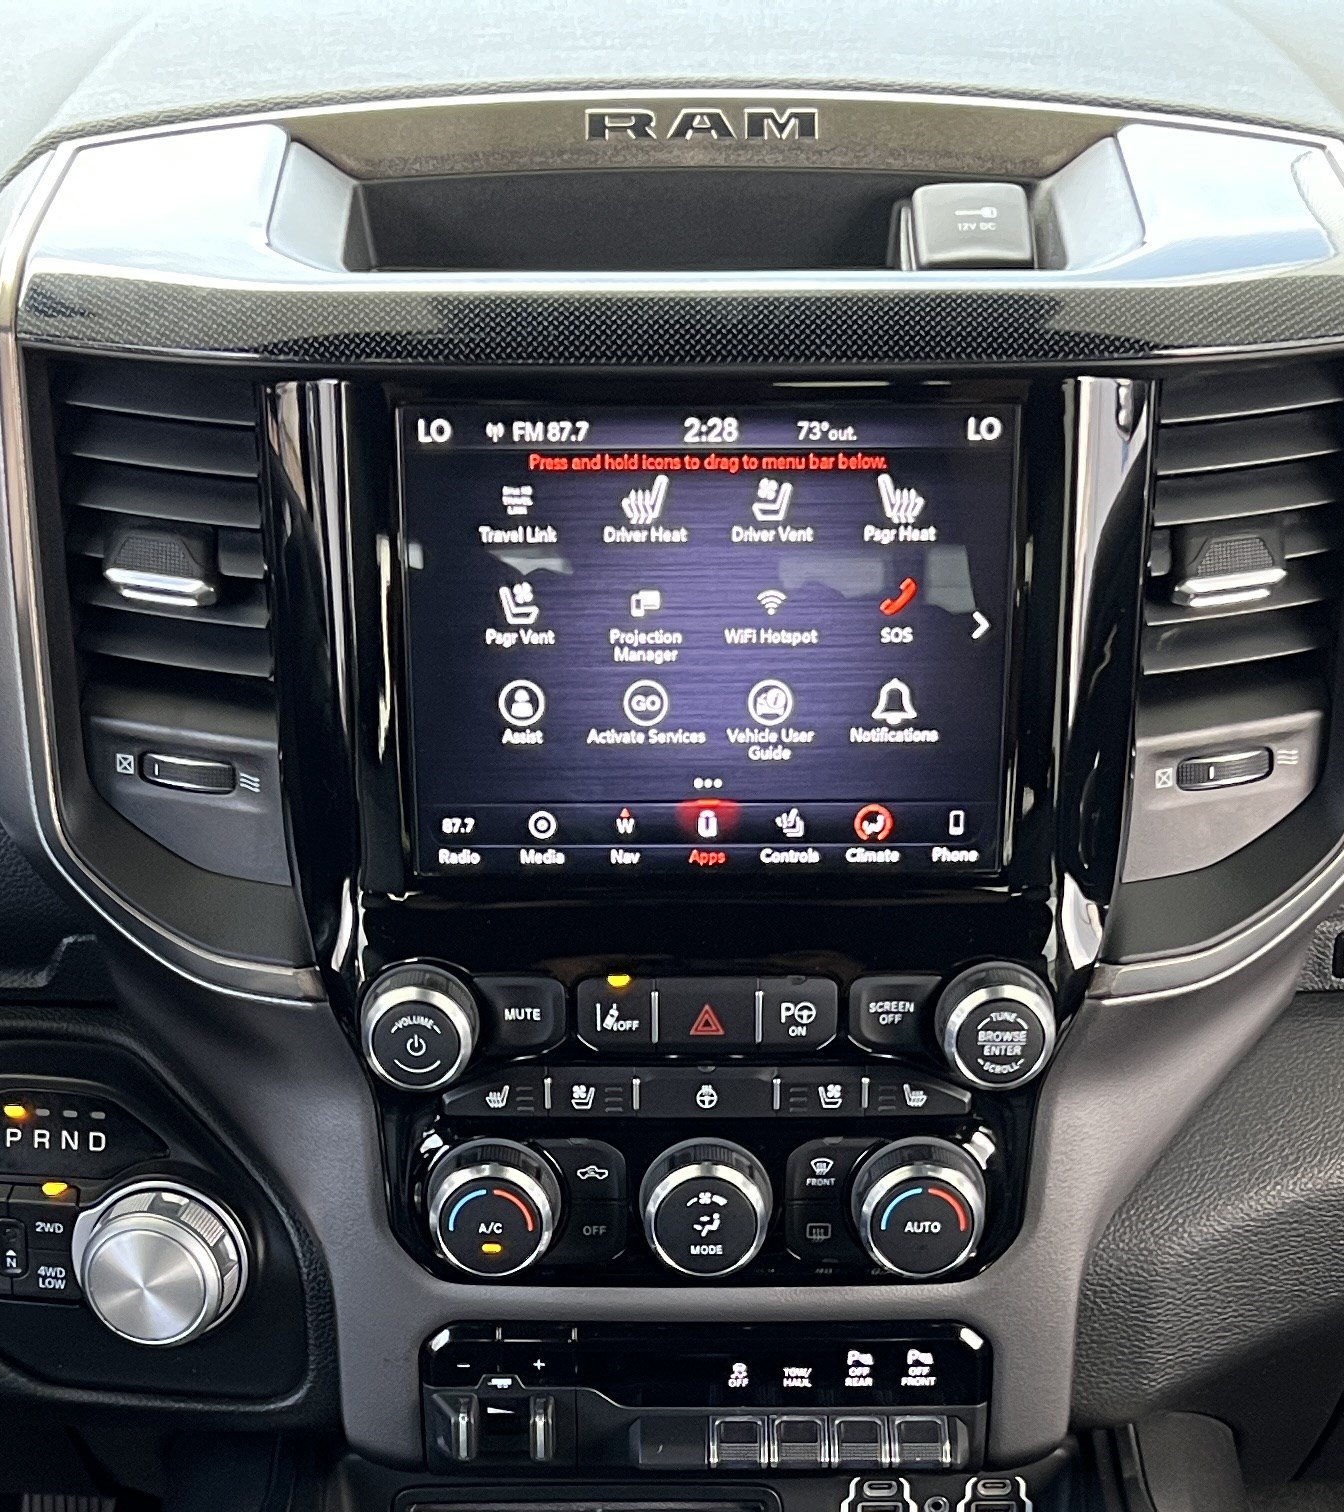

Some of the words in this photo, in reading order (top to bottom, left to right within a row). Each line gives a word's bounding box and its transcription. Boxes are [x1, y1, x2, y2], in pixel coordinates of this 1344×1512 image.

[585, 107, 818, 140] RAM
[957, 222, 977, 231] 12V
[417, 418, 452, 443] LO
[512, 421, 543, 442] FM
[546, 421, 589, 442] 87.7
[683, 417, 739, 443] 2:28
[967, 416, 1002, 441] LO
[528, 453, 568, 470] Press
[572, 453, 602, 470] and
[605, 453, 638, 470] hold
[642, 453, 681, 470] icons
[684, 453, 700, 470] to
[704, 453, 739, 474] drag
[743, 453, 759, 470] to
[762, 457, 806, 470] menu
[809, 453, 835, 470] bar
[838, 453, 888, 470] below.
[479, 525, 524, 543] Travel
[526, 525, 557, 543] Link
[604, 525, 647, 543] Driver
[650, 526, 688, 543] Heat
[731, 525, 775, 542] Driver
[778, 525, 814, 542] Vent
[863, 525, 897, 544] Psgr
[898, 525, 936, 542] Heat
[485, 628, 518, 648] Psgr
[519, 629, 555, 645] Vent
[609, 628, 682, 647] Projection
[724, 628, 757, 645] WiFi
[759, 628, 818, 646] Hotspot
[880, 627, 913, 644] SOS
[613, 646, 678, 664] Manager
[631, 694, 661, 712] GO
[502, 728, 544, 744] Assist
[586, 728, 645, 744] Activate
[648, 728, 706, 744] Services
[726, 728, 778, 744] Vehicle
[781, 728, 815, 744] User
[850, 727, 939, 743] Notifications
[748, 745, 792, 761] Guide
[442, 817, 475, 834] 87.7
[438, 849, 481, 865] Radio
[520, 849, 566, 865] Media
[610, 849, 641, 864] Nav
[688, 849, 726, 866] Apps
[760, 848, 821, 864] Controls
[845, 847, 901, 864] Climate
[931, 847, 979, 863] Phone
[504, 1007, 541, 1021] MUTE
[869, 1001, 914, 1013] SCREEN
[395, 1015, 434, 1029] VOLUME
[617, 1020, 639, 1031] OFF
[879, 1013, 902, 1025] OFF
[788, 1026, 806, 1037] ON
[978, 1030, 1027, 1042] BROWSE
[983, 1045, 1022, 1056] ENTER
[6, 1128, 22, 1148] P
[33, 1129, 51, 1149] R
[61, 1130, 78, 1151] N
[89, 1131, 106, 1152] D
[806, 1177, 835, 1187] FRONT
[35, 1222, 64, 1234] 2WD
[478, 1222, 503, 1235] A/C
[582, 1225, 606, 1237] OFF
[904, 1221, 941, 1234] AUTO
[690, 1245, 723, 1255] MODE
[6, 1256, 17, 1269] N
[37, 1266, 66, 1279] 4WD
[38, 1278, 66, 1290] LOW
[848, 1367, 871, 1377] OFF
[908, 1366, 931, 1376] OFF
[728, 1378, 749, 1388] OFF
[783, 1377, 812, 1388] HAUL
[845, 1377, 874, 1387] REAR
[900, 1376, 937, 1387] FRONT
